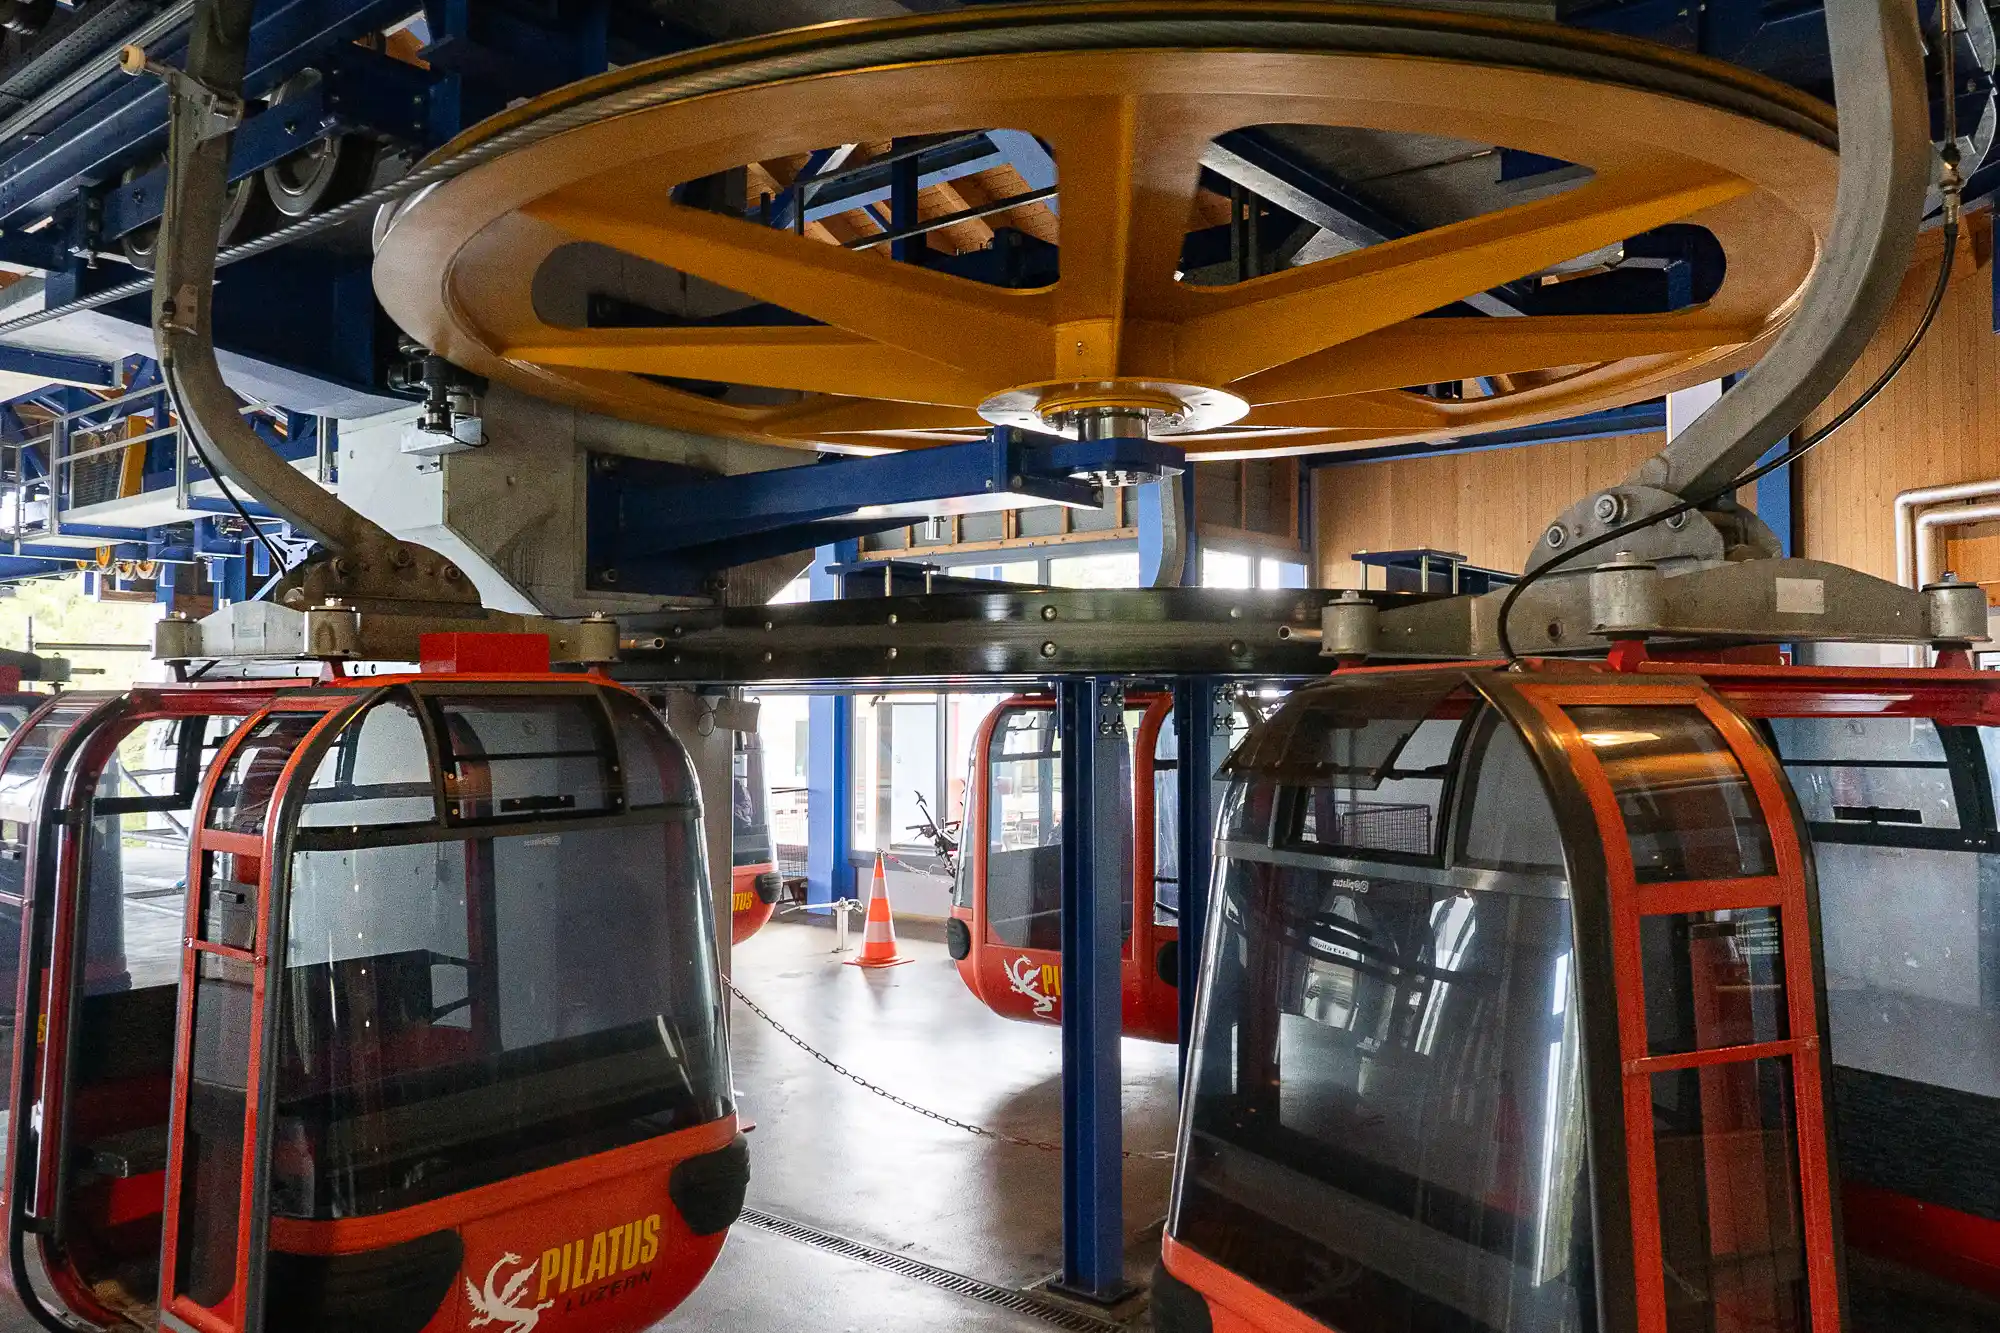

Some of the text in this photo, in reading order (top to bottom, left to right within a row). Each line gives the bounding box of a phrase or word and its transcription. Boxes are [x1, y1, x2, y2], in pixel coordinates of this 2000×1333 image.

[1041, 964, 1061, 996] PI
[537, 1213, 661, 1302] PILATUS
[565, 1270, 653, 1312] LUZERN
